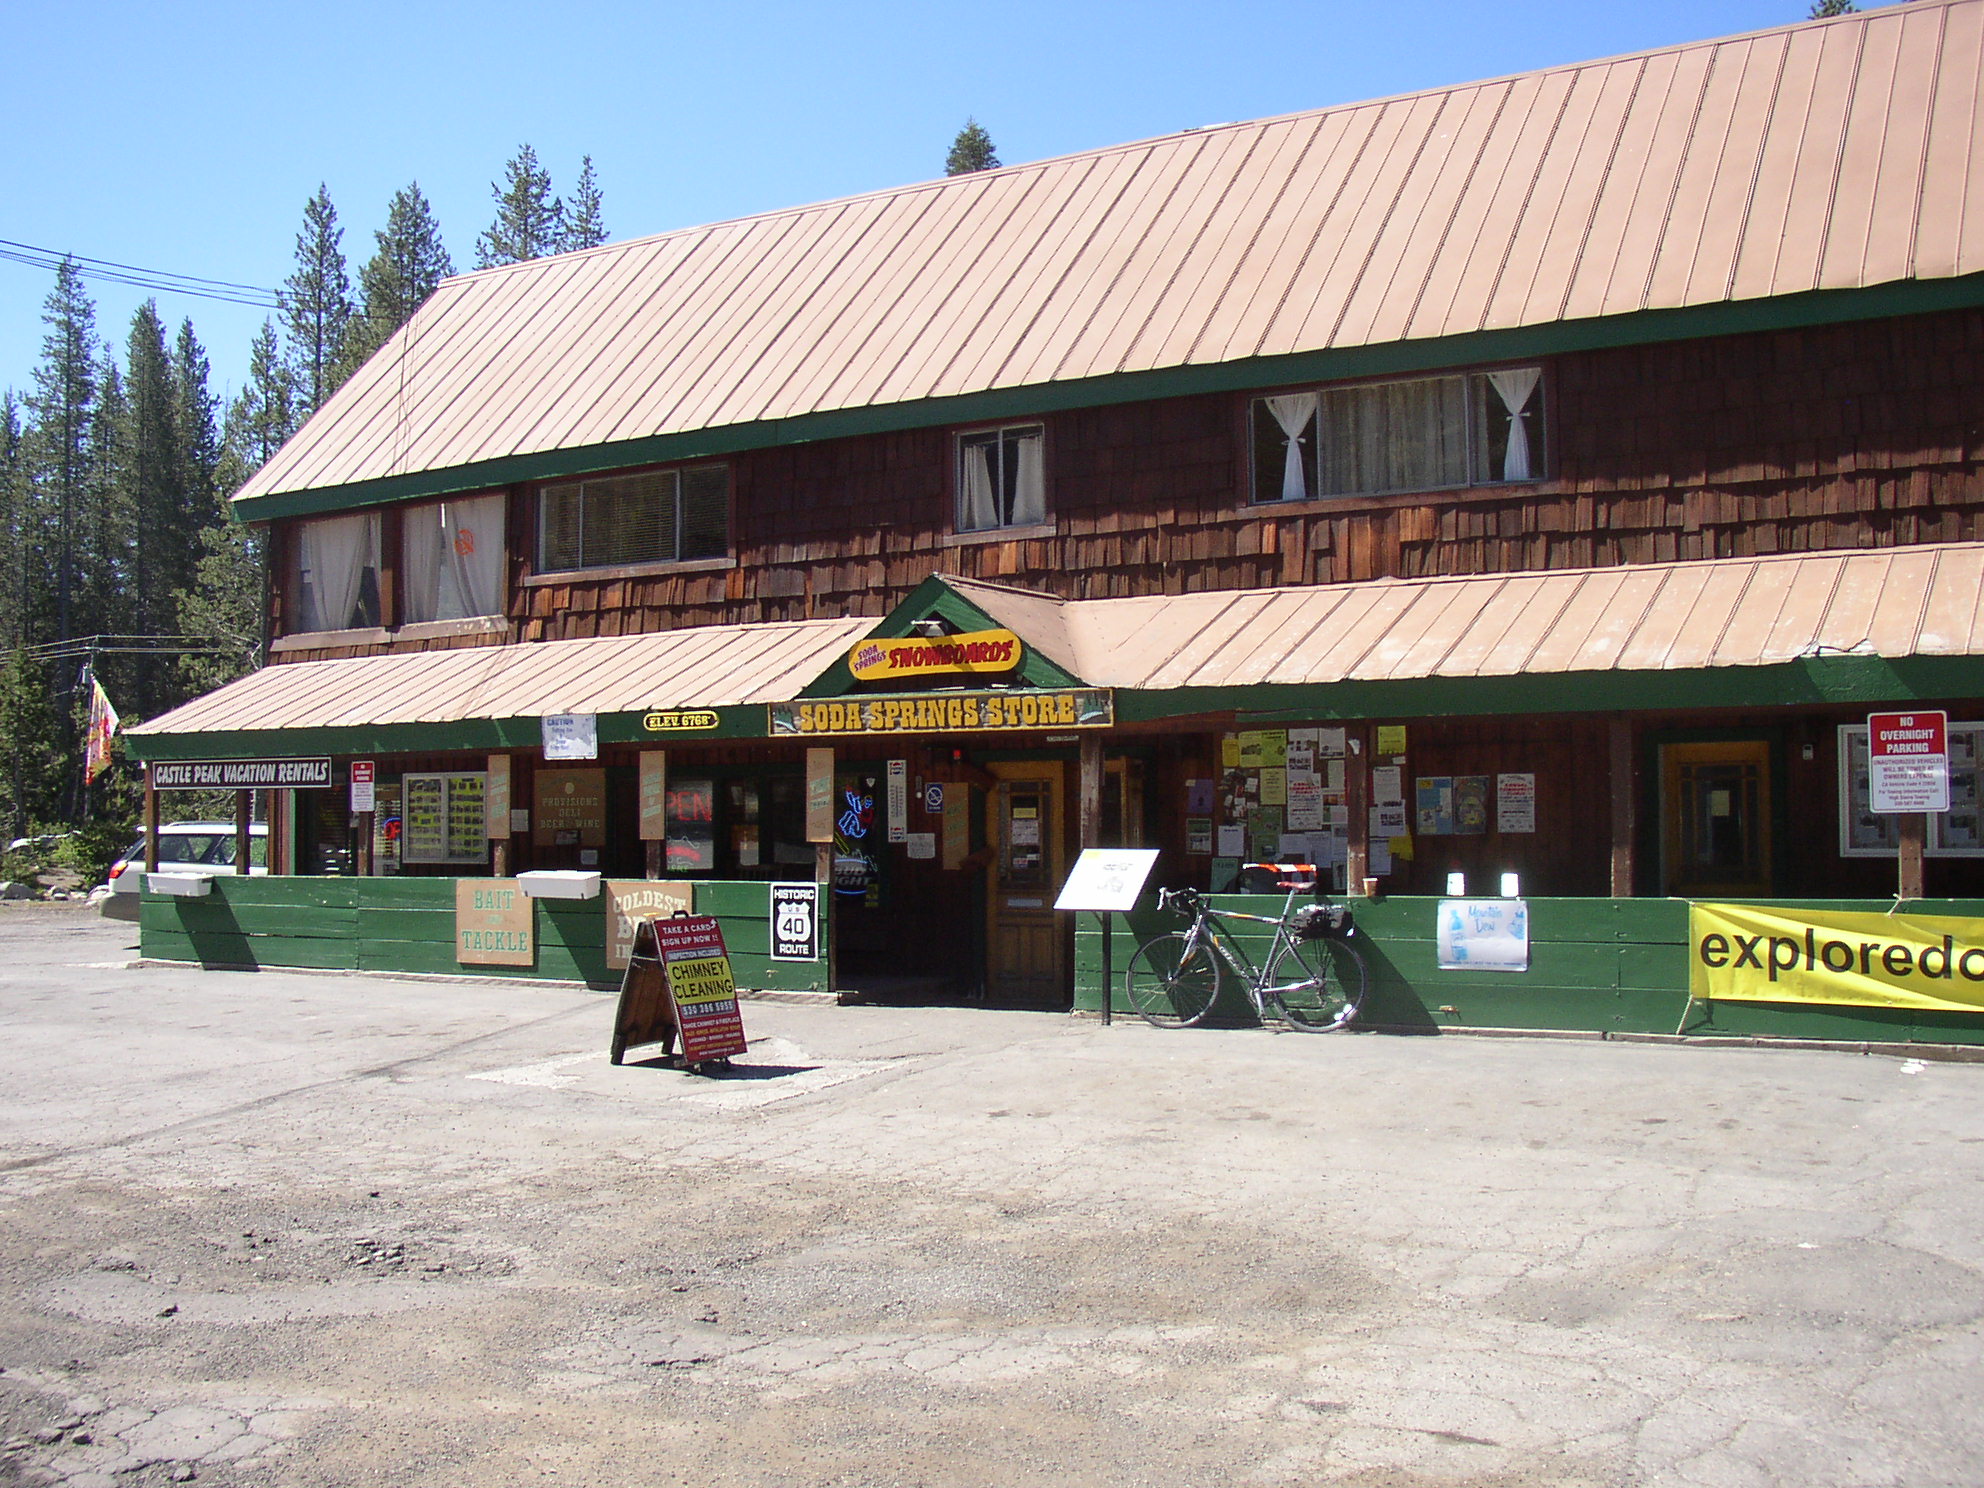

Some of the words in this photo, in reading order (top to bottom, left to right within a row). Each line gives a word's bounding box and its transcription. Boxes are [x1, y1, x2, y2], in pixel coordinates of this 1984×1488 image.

[853, 650, 887, 672] SPRINGS
[858, 644, 878, 660] SODA
[888, 640, 1014, 669] SNOWBOARDS
[800, 702, 862, 731] SODA
[869, 698, 979, 729] SPRINGS
[986, 694, 1075, 725] STORE
[1899, 716, 1914, 727] NO
[1880, 728, 1935, 741] OVERNIGHT
[1886, 742, 1929, 754] PARKING
[156, 765, 192, 784] CASTLE
[193, 764, 223, 784] PEAK
[224, 763, 276, 784] VACATION
[278, 762, 328, 783] RENTALS
[542, 797, 599, 807] PROVISIONS
[666, 791, 713, 823] PEN
[473, 889, 516, 911] BAIT
[612, 890, 687, 914] COLDEST
[774, 888, 815, 900] HISTORIC
[662, 925, 683, 934] TAKE
[684, 925, 690, 933] A
[690, 923, 711, 932] CARD
[782, 917, 804, 935] 40
[462, 928, 529, 953] TACKLE
[661, 937, 680, 947] SIGN
[681, 936, 692, 945] UP
[693, 934, 711, 943] NOW
[779, 943, 809, 955] ROUTE
[671, 961, 725, 981] CHIMNEY
[673, 979, 733, 1000] CLEANING
